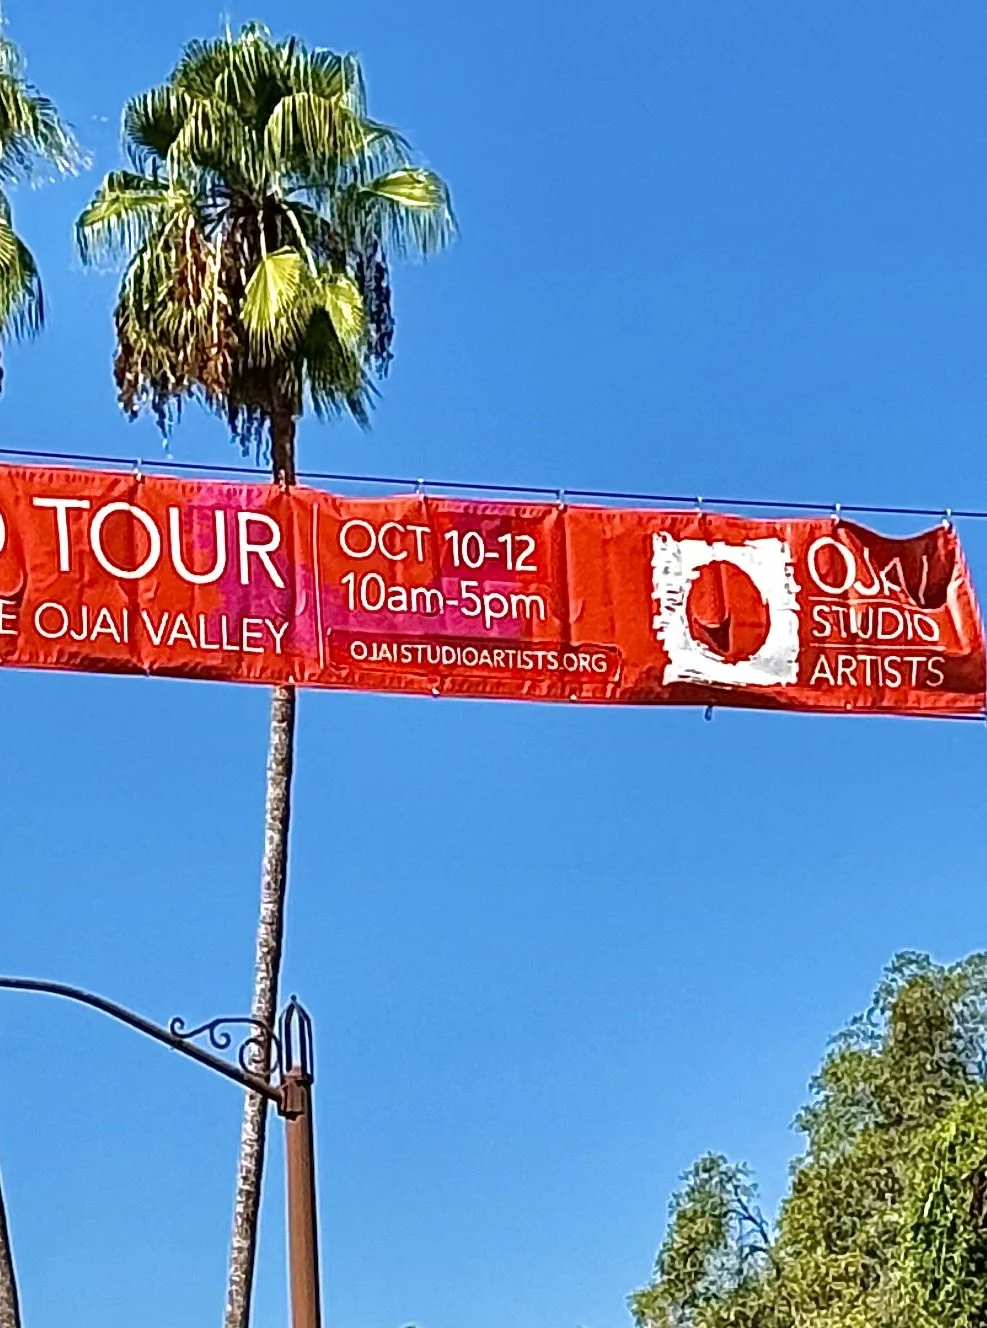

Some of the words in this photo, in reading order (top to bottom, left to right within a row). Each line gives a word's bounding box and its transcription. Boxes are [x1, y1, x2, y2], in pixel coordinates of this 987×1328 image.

[33, 496, 285, 588] TOUR
[339, 519, 431, 562] OCT
[444, 530, 538, 572] 10-12
[807, 536, 927, 605] OJAI
[340, 571, 545, 629] 10am-5pm
[811, 605, 940, 642] STUDIO
[33, 600, 129, 645] OJAI
[141, 611, 289, 656] VALLEY
[349, 640, 607, 673] OJAISTUDIOARTISTS.ORG
[809, 655, 946, 688] ARTISTS
